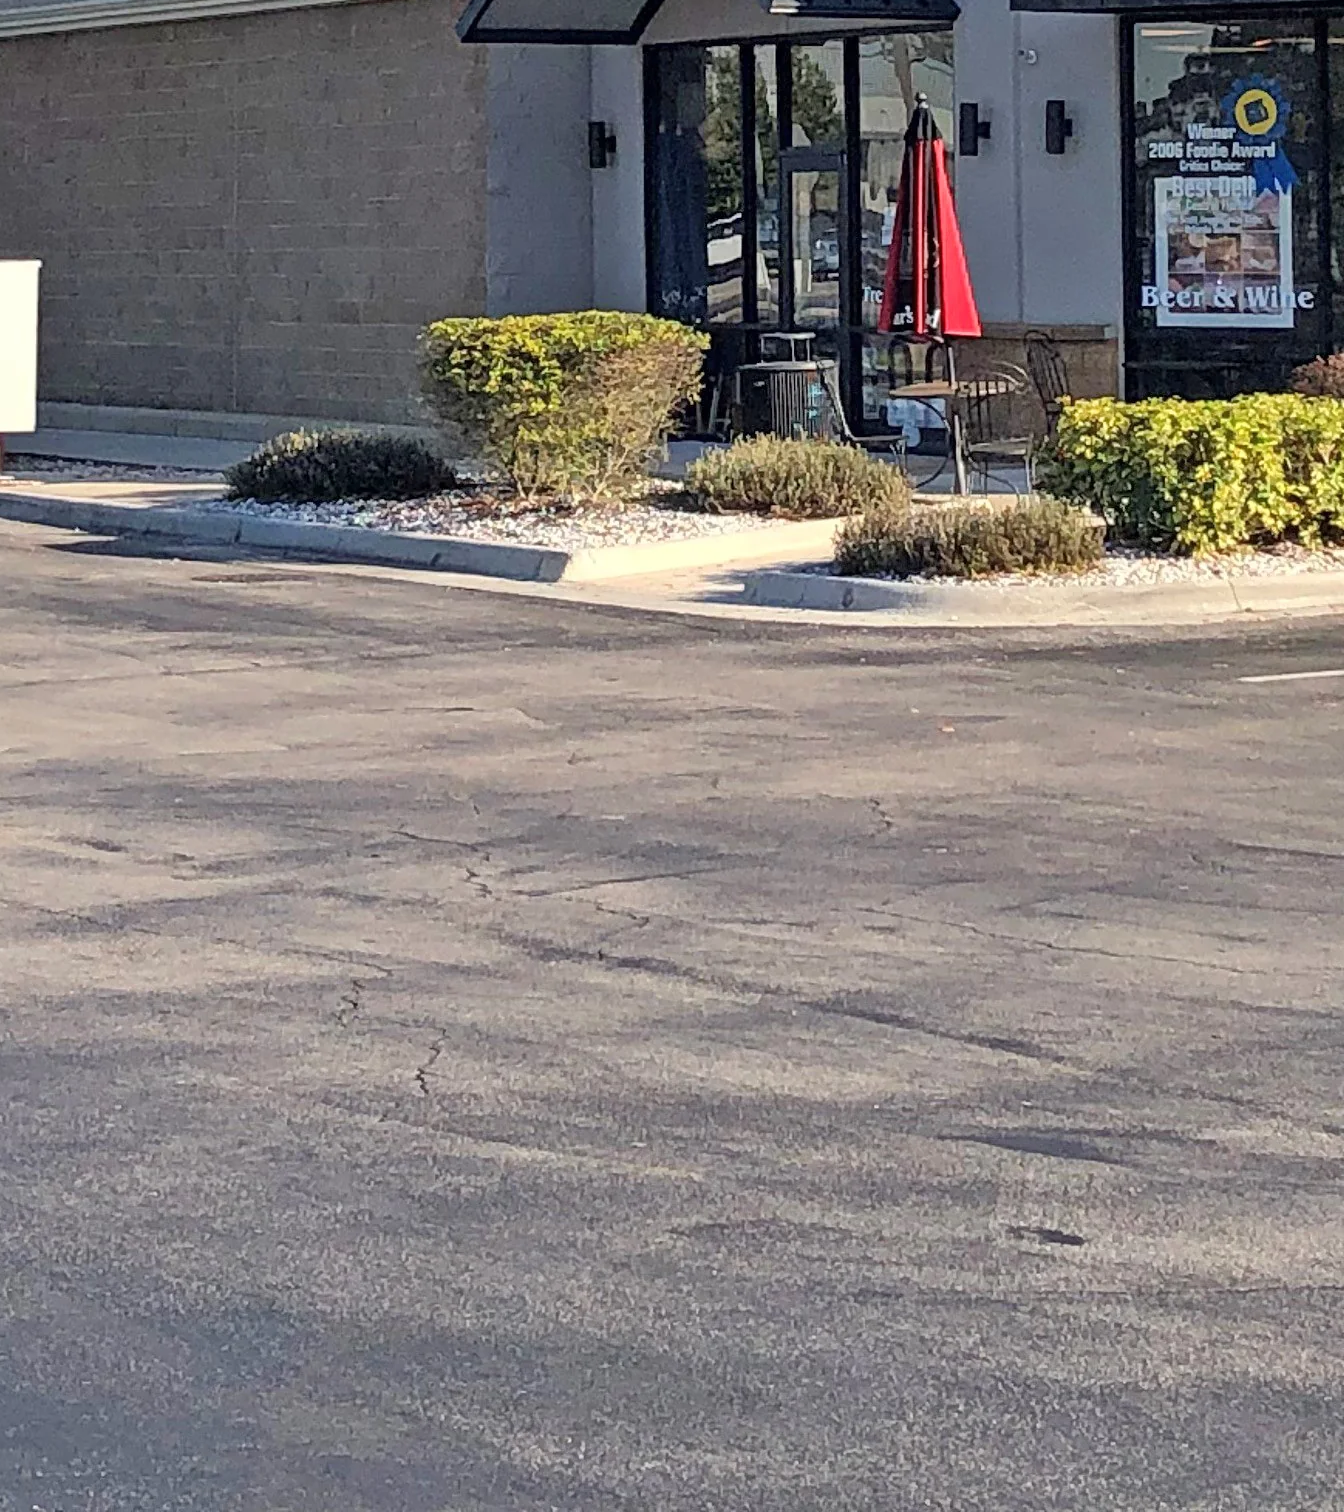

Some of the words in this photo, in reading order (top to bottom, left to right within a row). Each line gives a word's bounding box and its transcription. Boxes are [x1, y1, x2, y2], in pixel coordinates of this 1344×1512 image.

[1232, 142, 1276, 158] Award
[1172, 176, 1211, 197] Best
[1142, 286, 1203, 308] Beer
[1213, 286, 1235, 308] &
[1245, 285, 1314, 308] Wine
